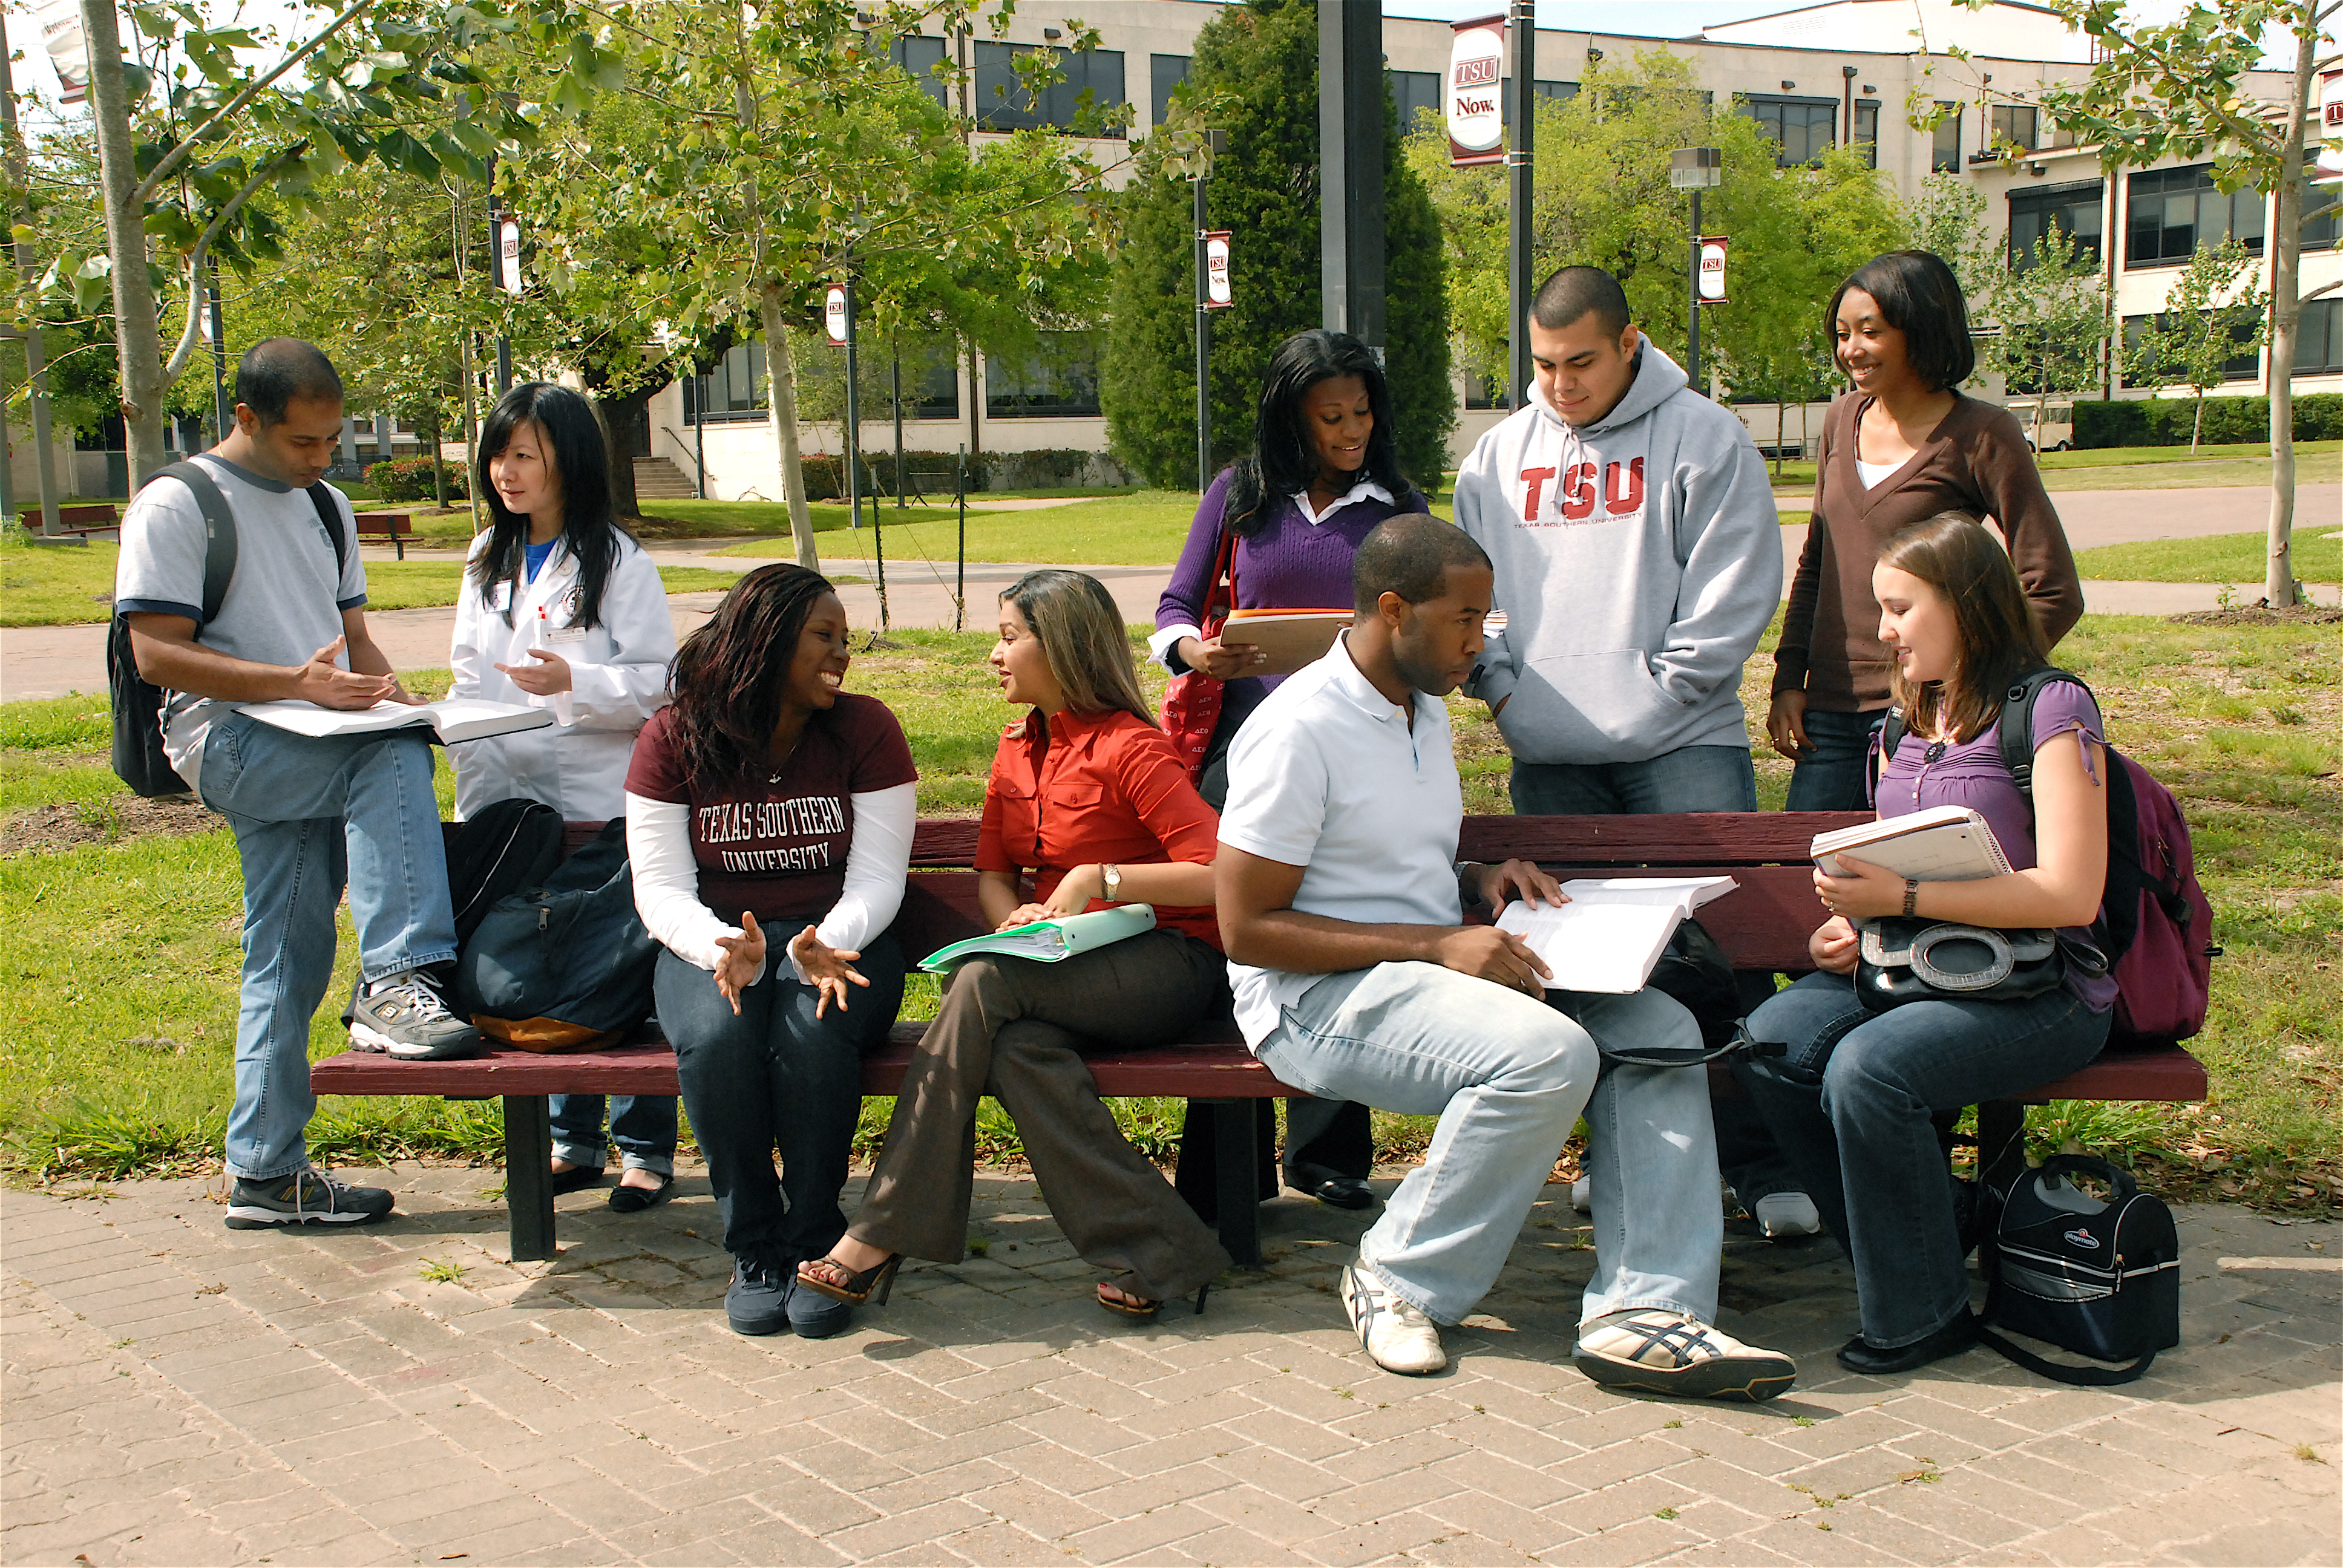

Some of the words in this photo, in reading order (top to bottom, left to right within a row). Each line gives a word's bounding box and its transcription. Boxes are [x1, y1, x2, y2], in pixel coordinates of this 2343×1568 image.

[1458, 60, 1494, 82] TSU
[1456, 96, 1494, 116] Now.
[505, 241, 516, 254] TSU
[1211, 256, 1224, 268] TSU
[1703, 259, 1720, 269] TSU
[830, 303, 842, 312] TSU
[1521, 456, 1643, 521] TSU
[1592, 512, 1642, 524] UNIVERSITY
[699, 802, 752, 843] TEXAS
[757, 797, 845, 838] SOUTHERN
[721, 841, 829, 872] UNIVERSITY
[2065, 1233, 2097, 1247] playmate
